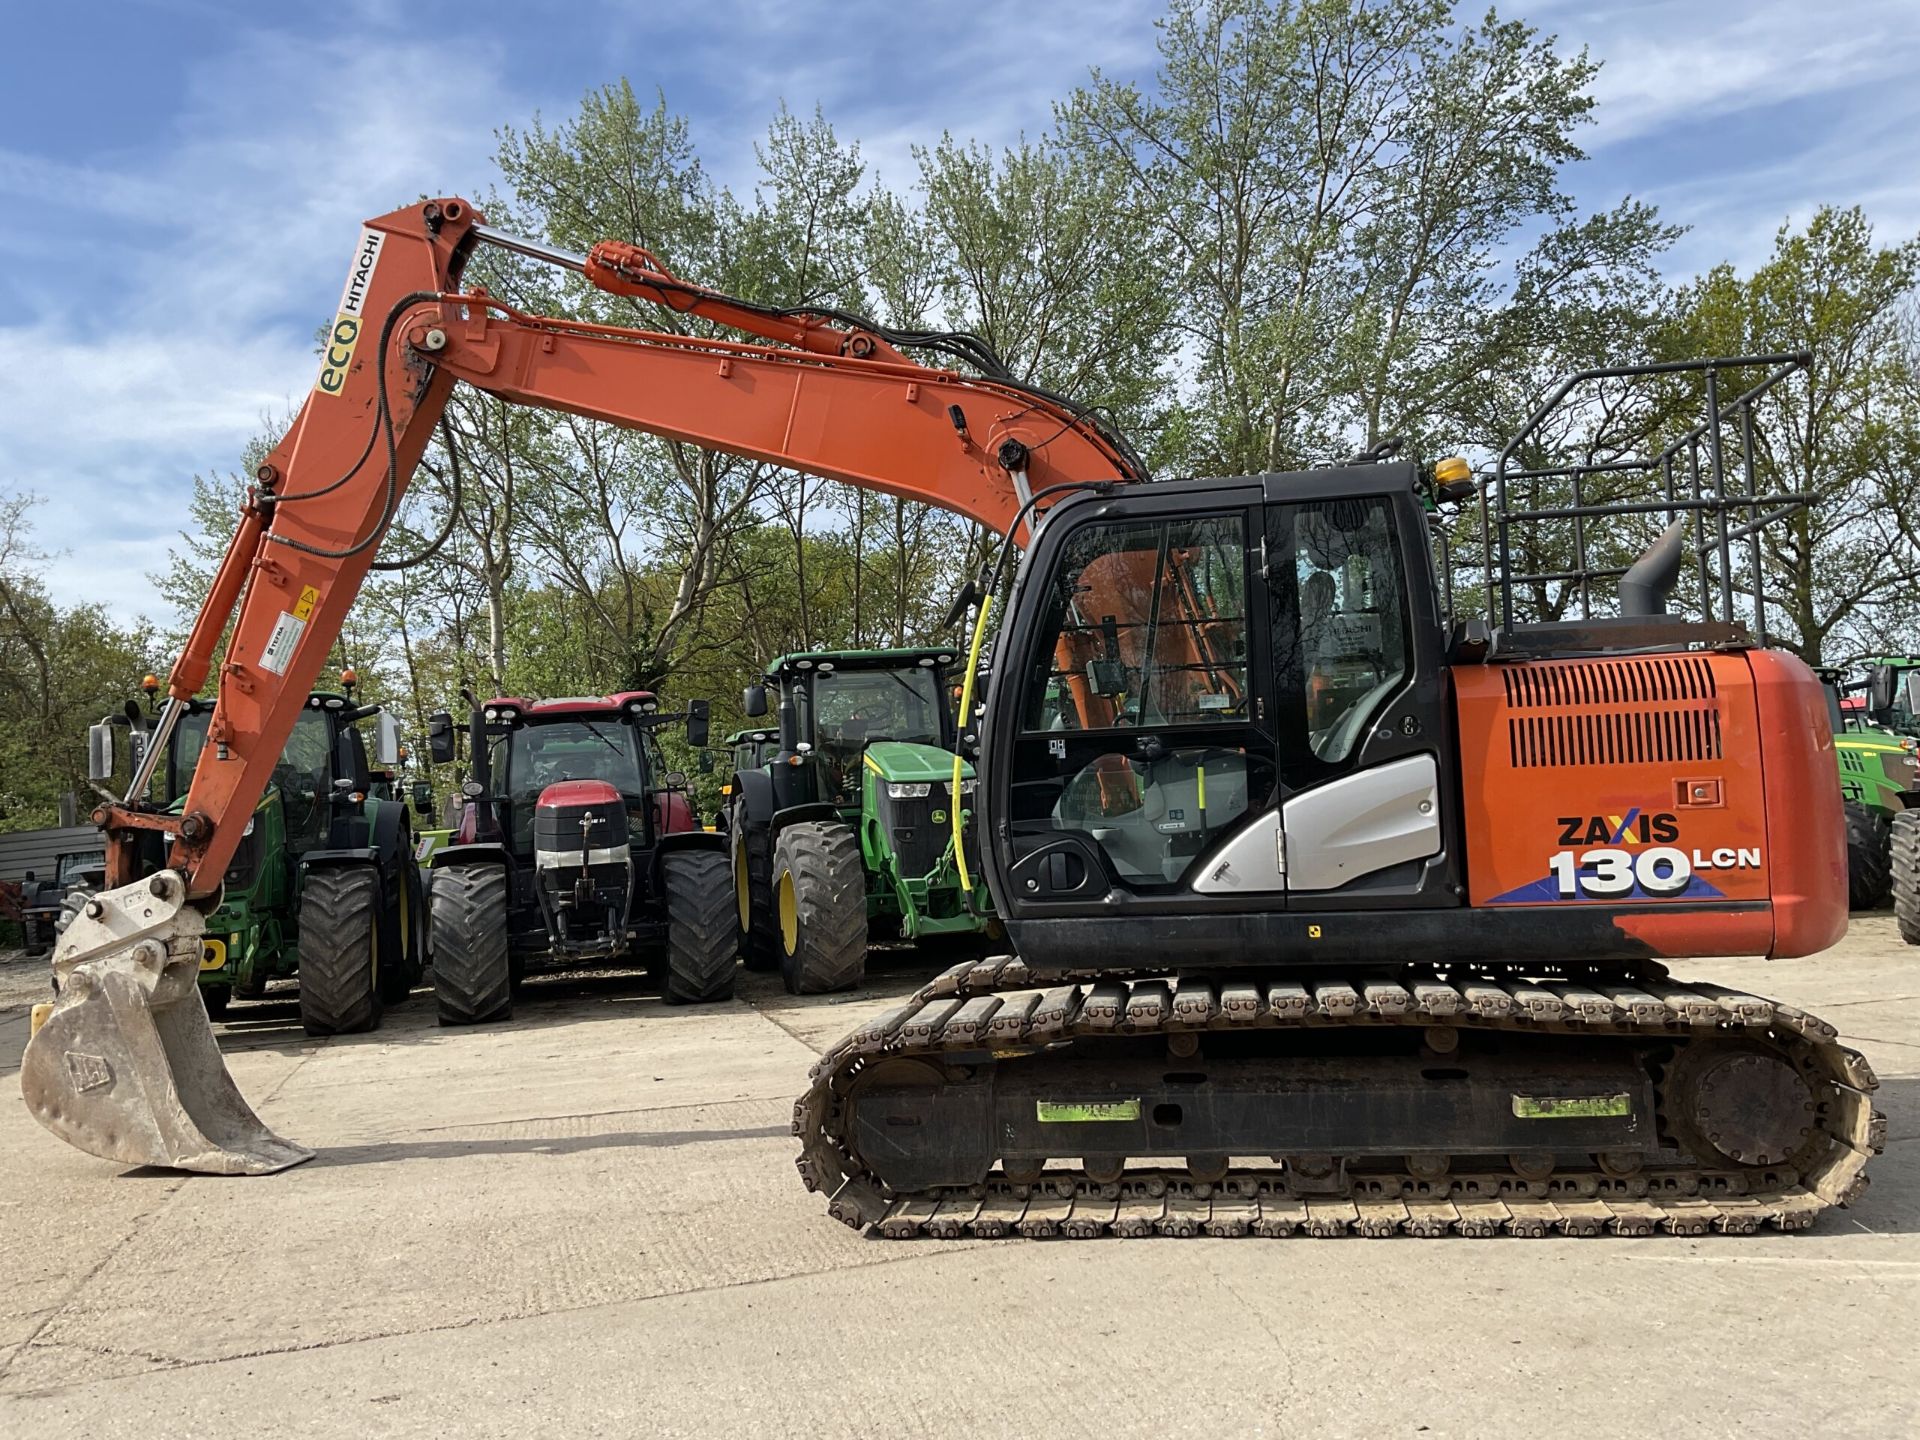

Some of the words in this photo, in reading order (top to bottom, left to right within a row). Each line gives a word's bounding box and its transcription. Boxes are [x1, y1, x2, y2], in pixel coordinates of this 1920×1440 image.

[345, 234, 380, 312] HITACHI
[1557, 808, 1679, 846] ZAXIS
[1549, 847, 1692, 898] 130
[1693, 848, 1761, 869] LCN
